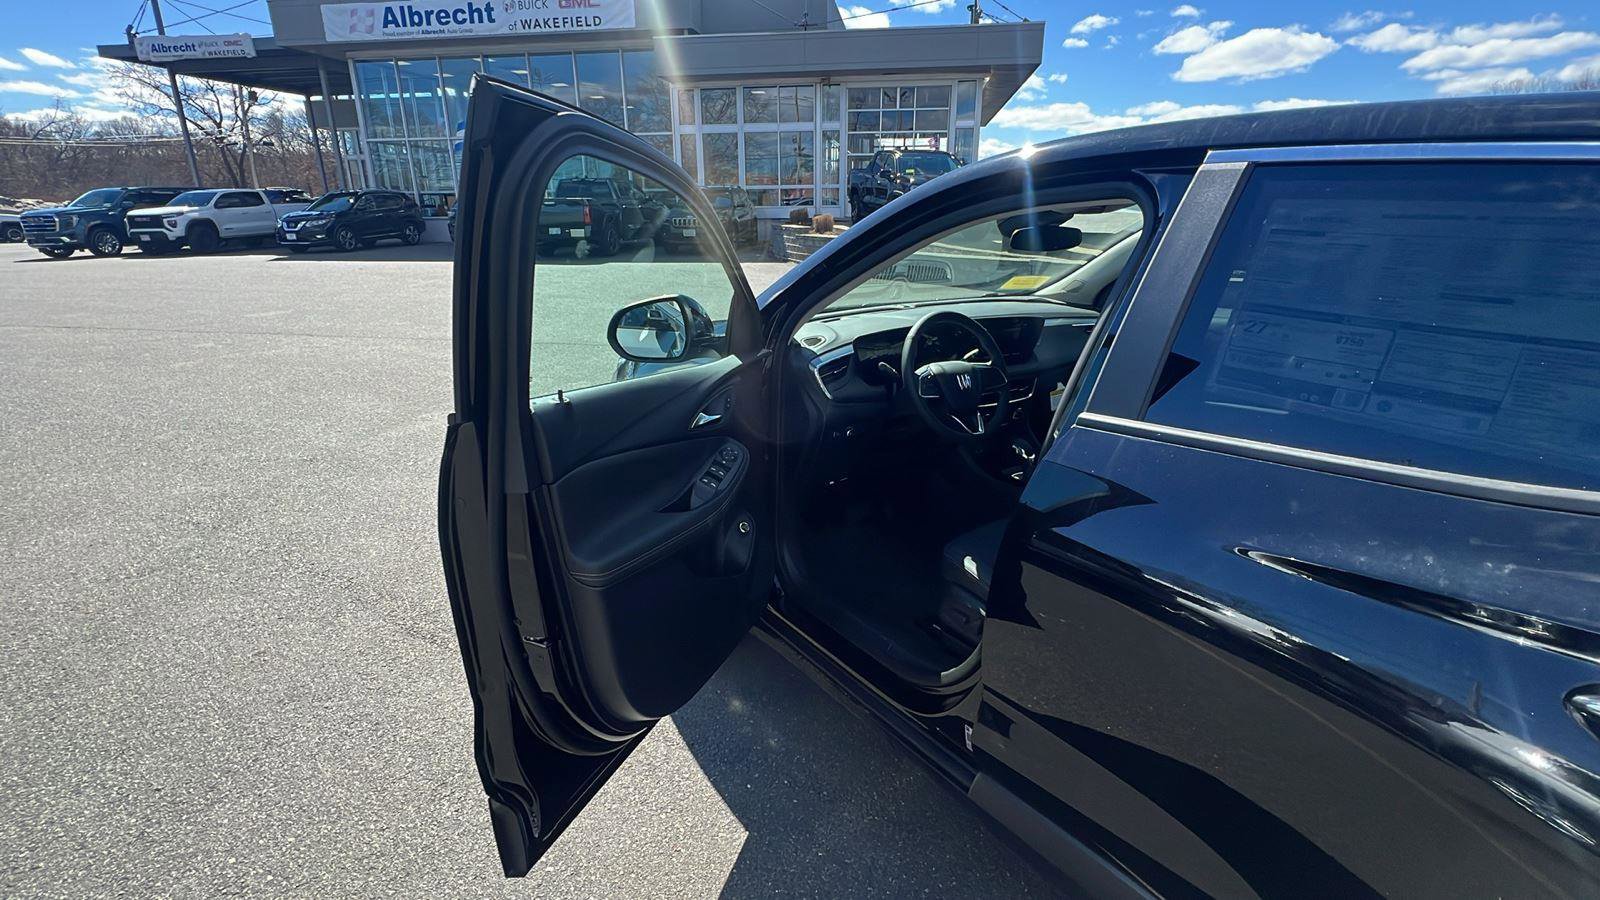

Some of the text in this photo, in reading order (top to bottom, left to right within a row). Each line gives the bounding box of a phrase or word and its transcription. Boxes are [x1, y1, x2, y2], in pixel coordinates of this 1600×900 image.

[518, 0, 549, 11] BUICK
[382, 1, 496, 29] Albrecht
[508, 16, 602, 31] of WAKEFIELD
[151, 42, 197, 53] Albrecht
[207, 49, 246, 57] WAKEFIELD
